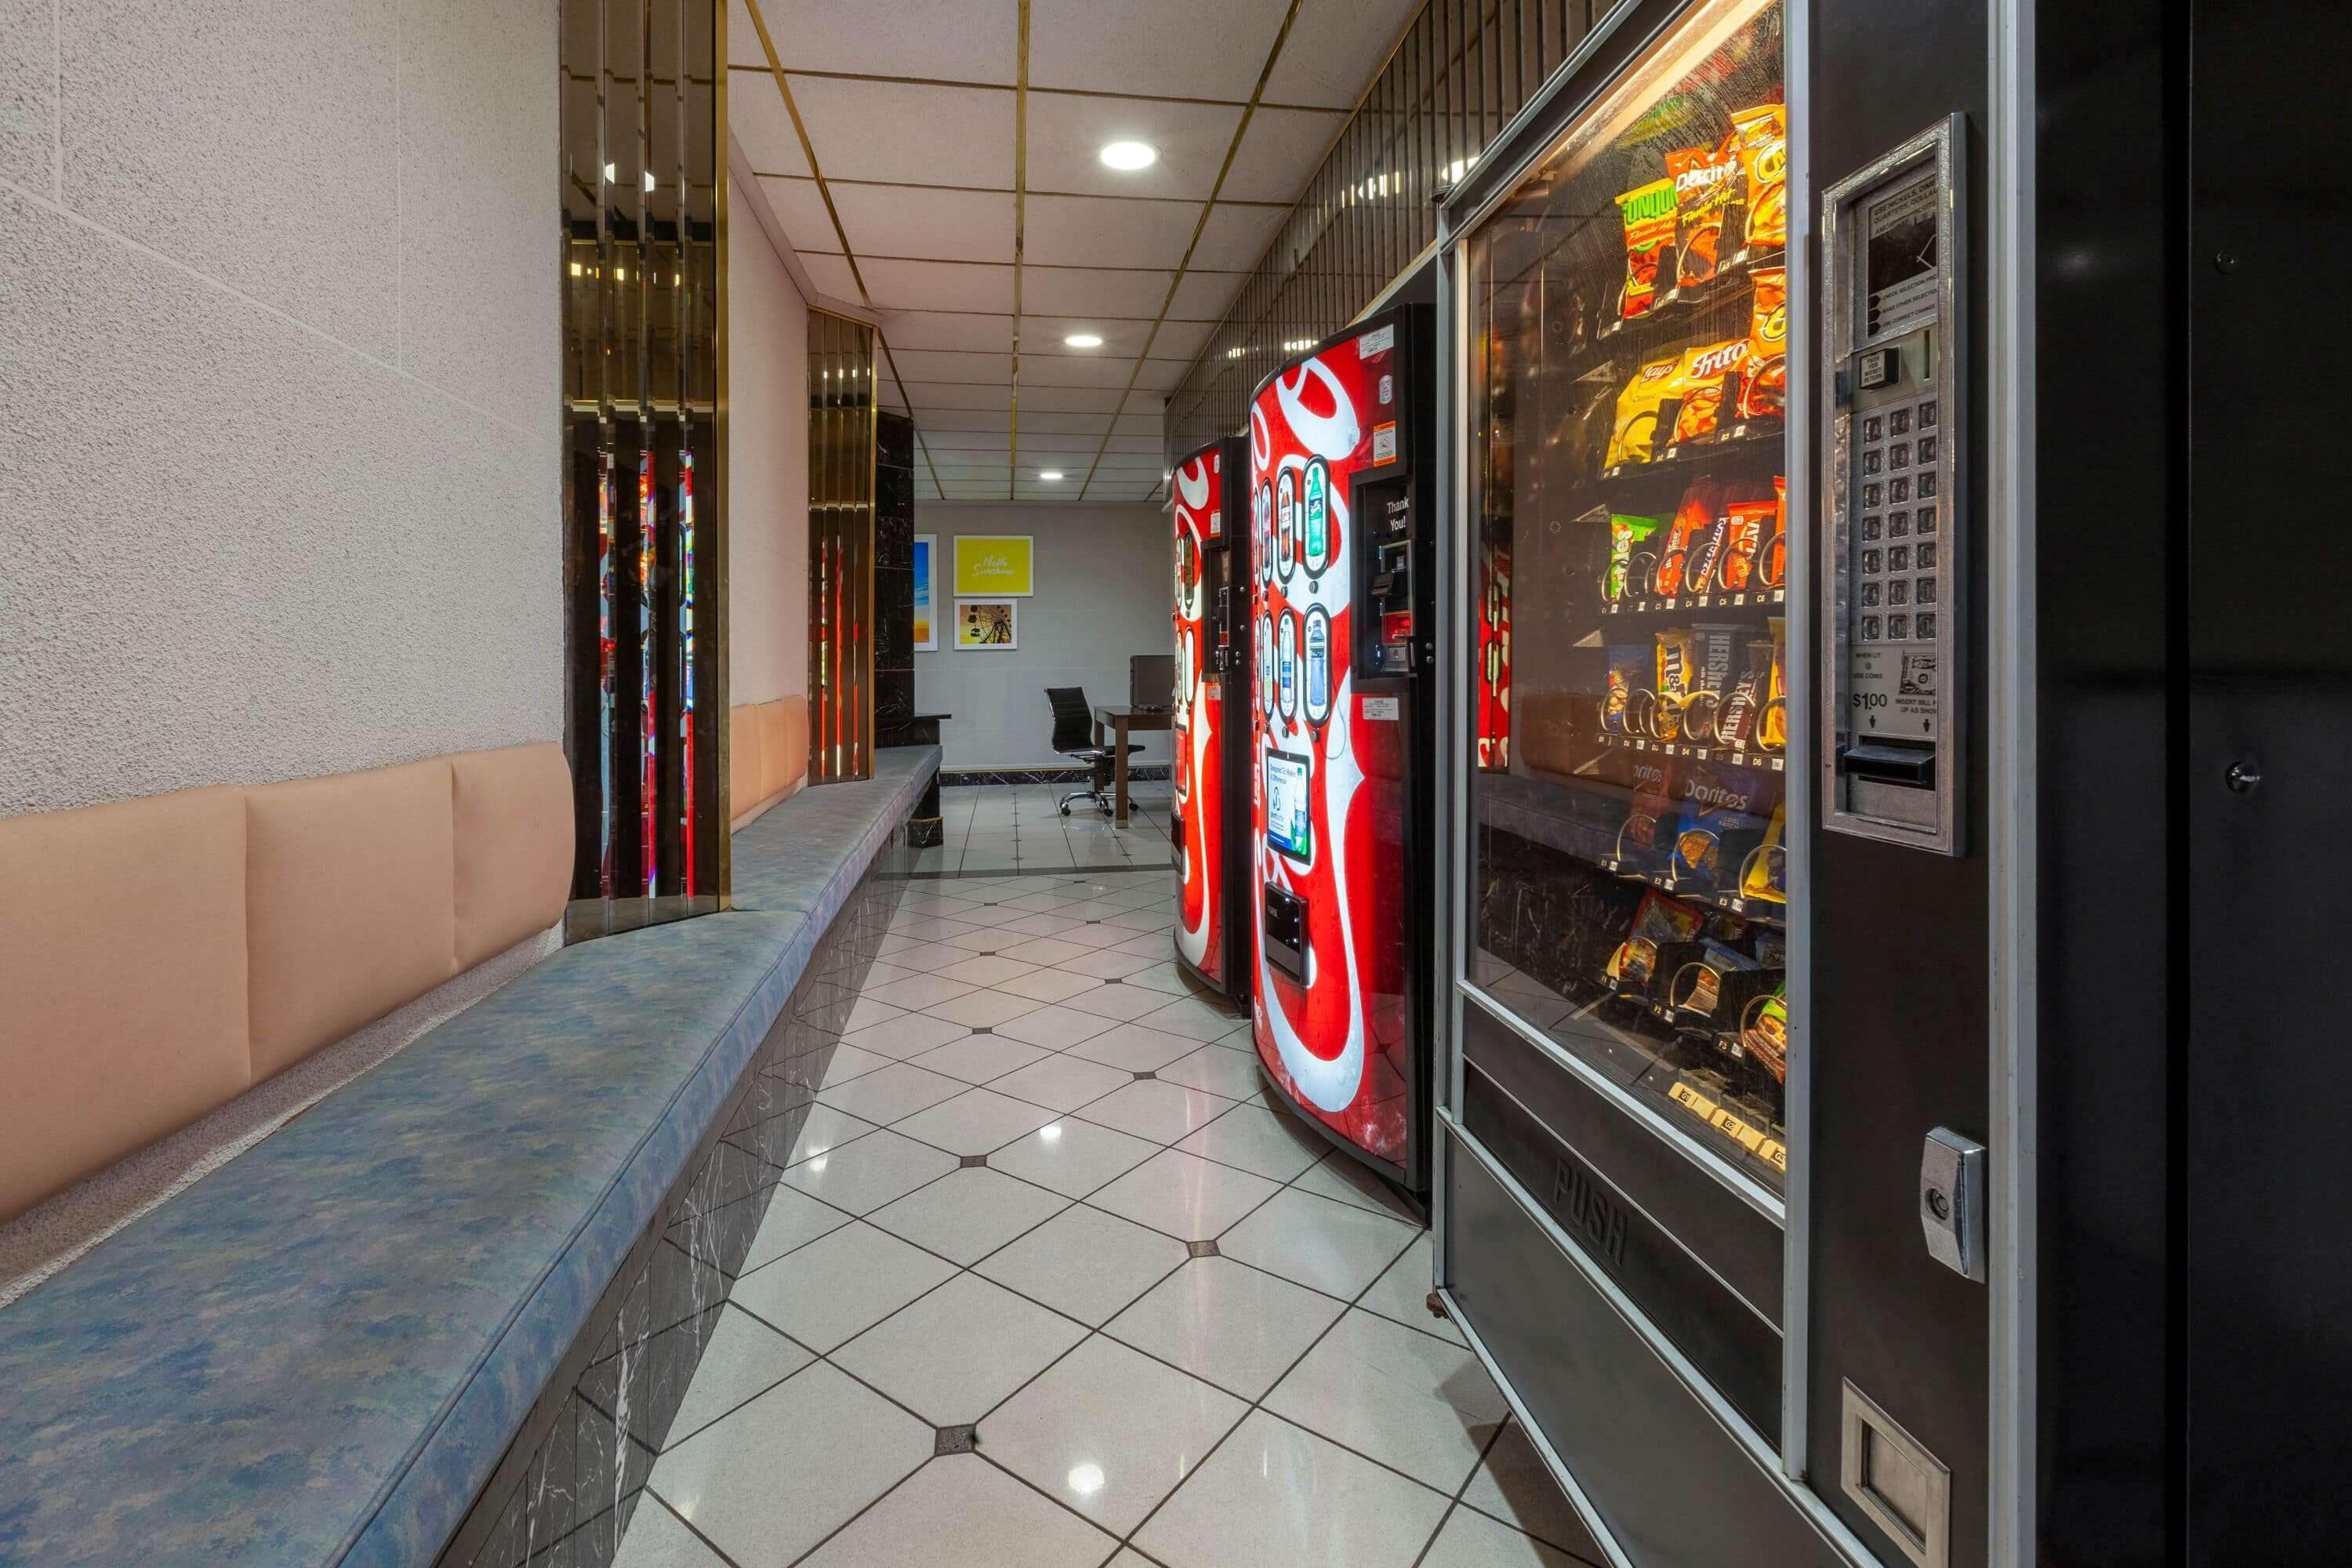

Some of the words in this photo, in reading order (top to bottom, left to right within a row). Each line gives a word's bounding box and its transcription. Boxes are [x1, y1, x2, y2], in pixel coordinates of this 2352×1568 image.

[1919, 178, 1936, 192] DIME
[1623, 184, 1678, 223] UNYUN
[1899, 279, 1924, 295] SELECTION
[1913, 289, 1937, 303] SELECTIO
[1892, 311, 1914, 324] CORRECT
[1915, 303, 1936, 315] CHANGE
[1691, 339, 1751, 379] Frito
[1387, 496, 1409, 514] Thank
[1390, 515, 1406, 532] You!
[984, 554, 1008, 567] Hello
[972, 564, 1014, 577] Sunshine
[1705, 633, 1731, 709] HERSHES
[1853, 692, 1888, 710] $1.00
[1719, 897, 1728, 906] E3
[1654, 1005, 1662, 1014] F2
[1719, 1040, 1727, 1050] F3
[1682, 1092, 1690, 1102] G1
[1725, 1120, 1735, 1130] G2
[1553, 1155, 1629, 1268] PUSH
